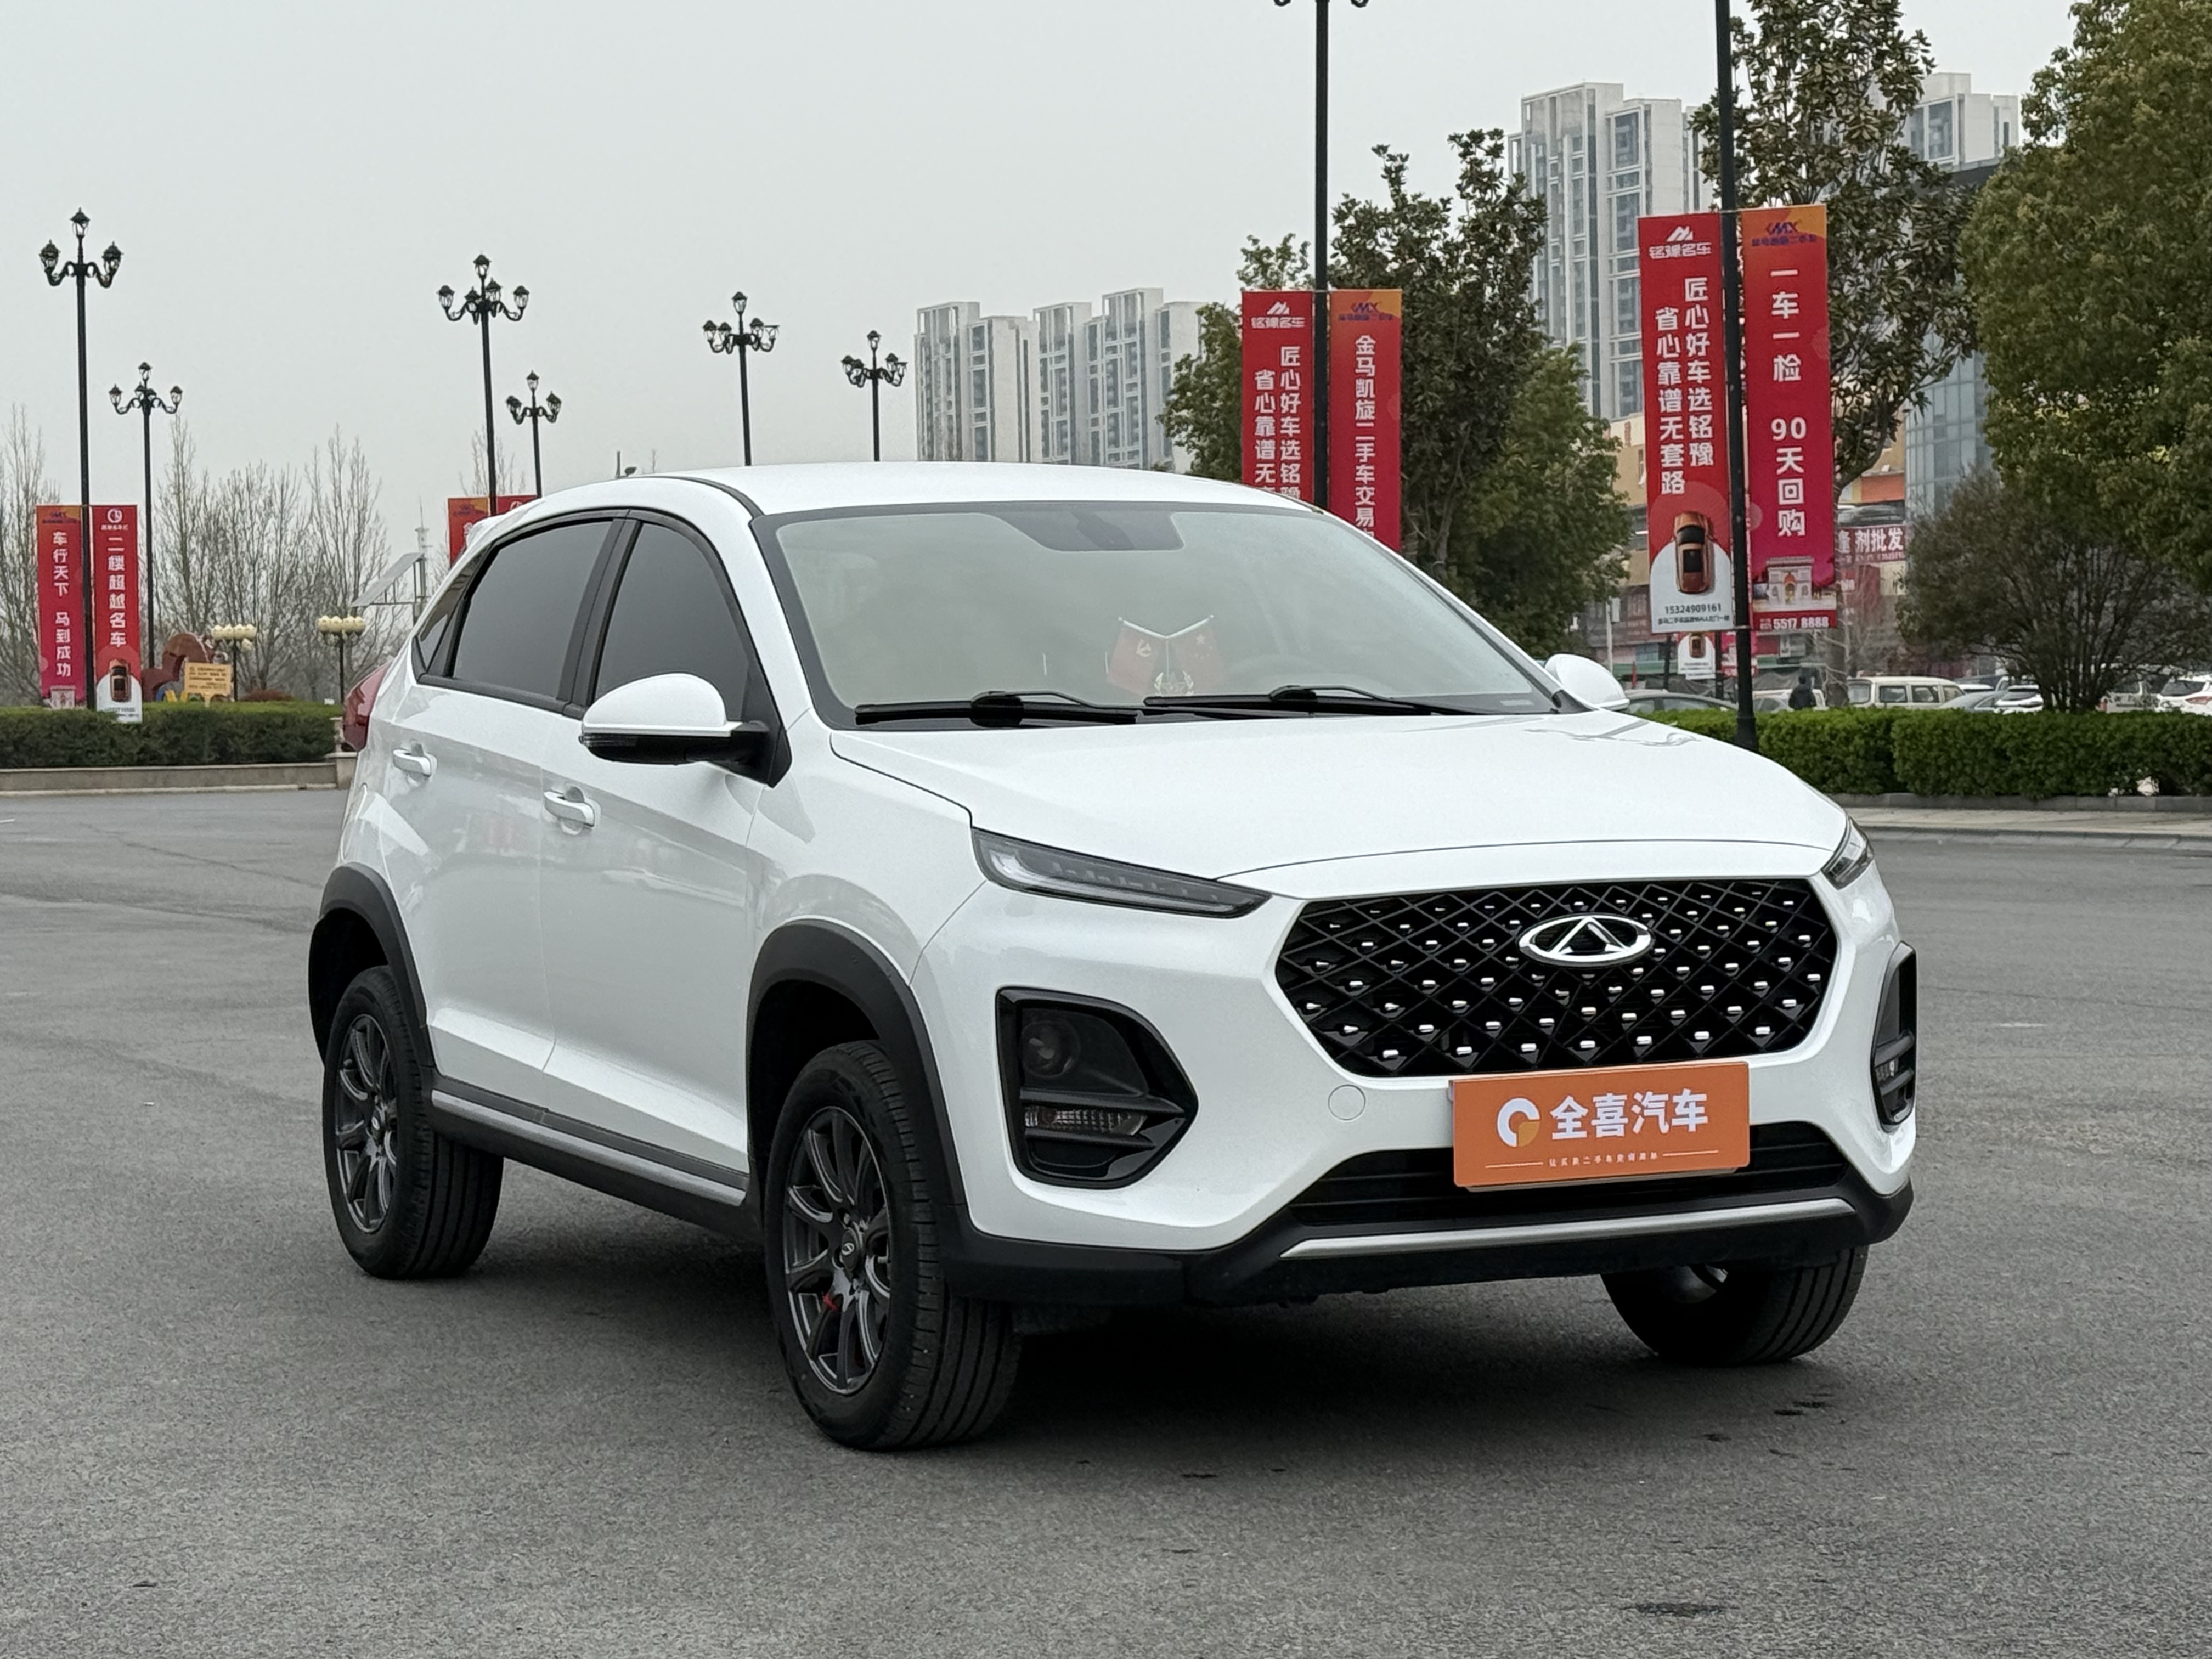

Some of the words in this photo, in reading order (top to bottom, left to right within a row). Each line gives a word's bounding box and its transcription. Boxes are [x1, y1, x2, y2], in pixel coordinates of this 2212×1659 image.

[1684, 276, 1714, 467] 匠心好车选铭豫
[1770, 269, 1801, 382] 一车一检
[1254, 369, 1276, 493] 省心靠谱无
[1355, 335, 1376, 538] 金马凯旋二手车交易
[1655, 307, 1685, 495] 省心靠谱无套路
[53, 531, 69, 597] 车行天下
[1664, 603, 1722, 614] 15324909161
[55, 612, 71, 677] 马到成功
[1549, 1088, 1709, 1140] 全喜汽车
